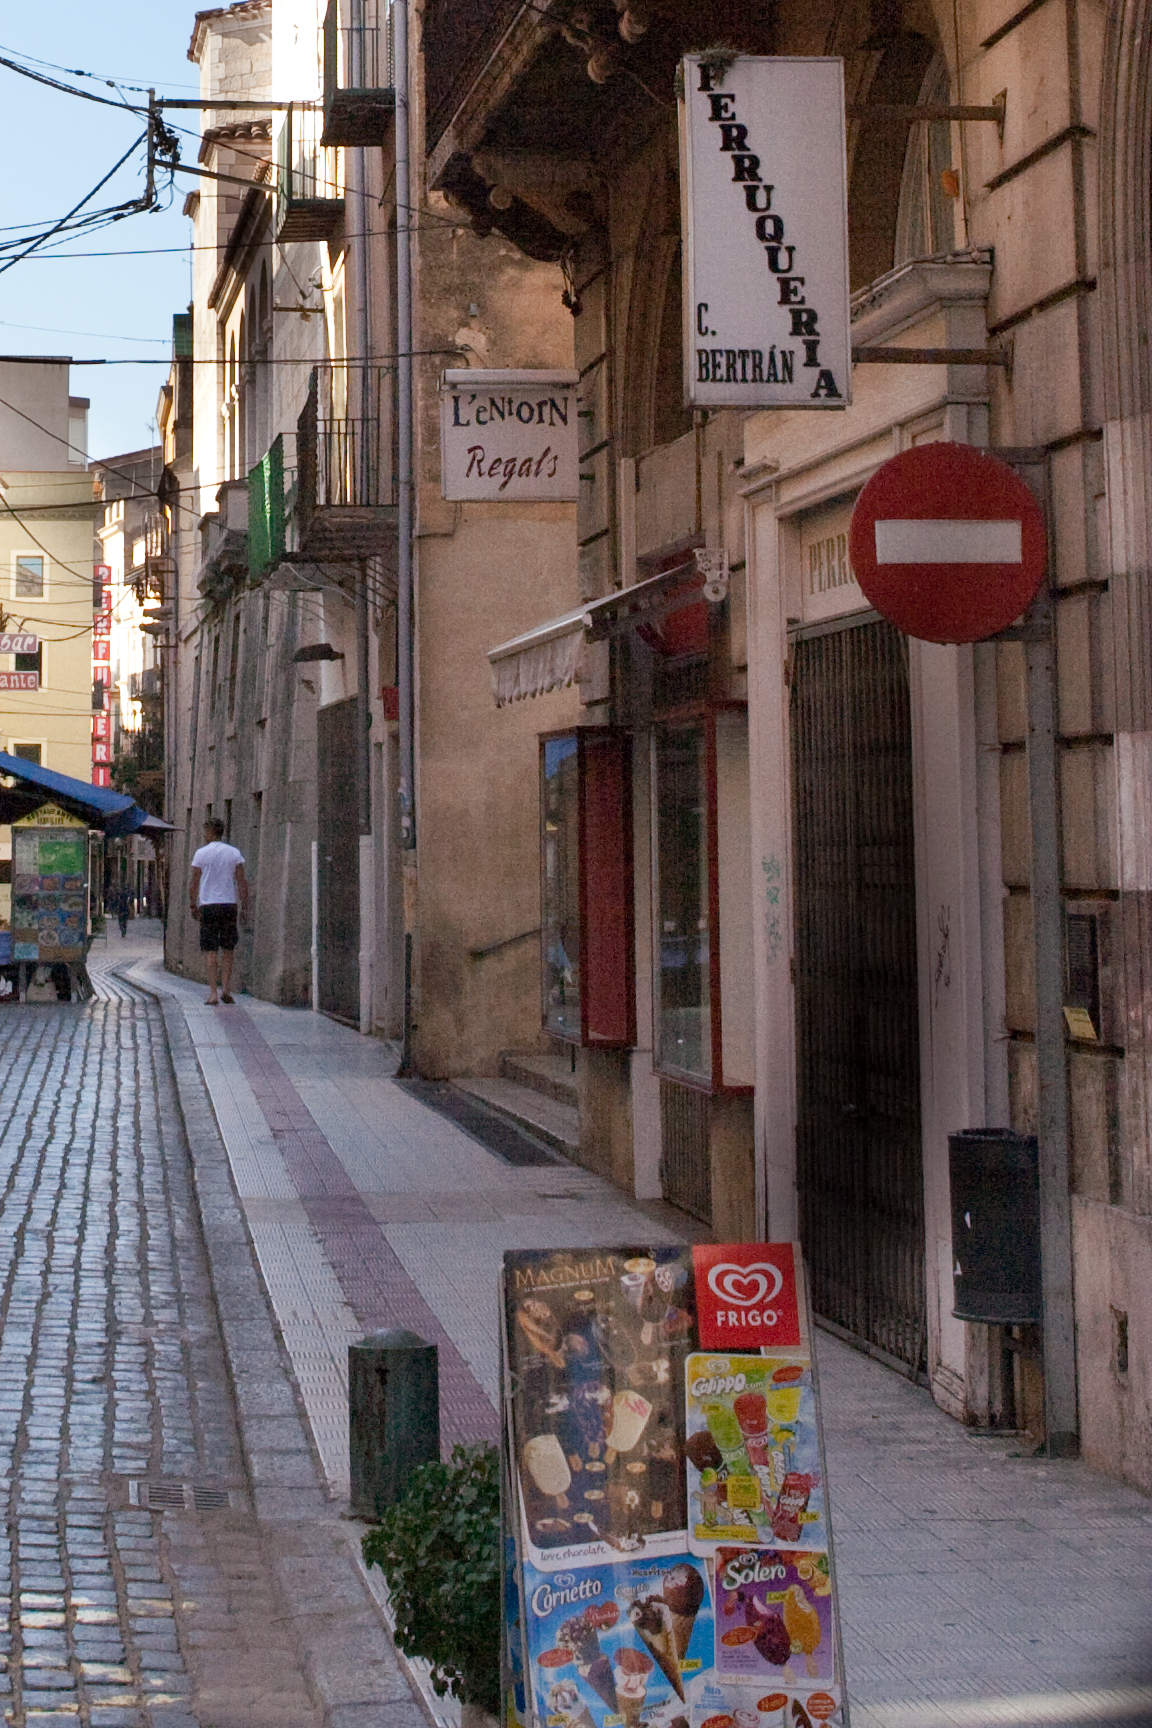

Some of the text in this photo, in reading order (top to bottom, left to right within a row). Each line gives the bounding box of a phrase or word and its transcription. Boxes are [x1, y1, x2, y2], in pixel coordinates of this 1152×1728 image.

[697, 62, 842, 399] PERRUQUERIA
[697, 302, 717, 337] C.
[696, 345, 795, 385] BERTRÁN
[465, 445, 559, 492] Regals
[514, 1255, 617, 1289] MAGNUM
[716, 1310, 778, 1327] FRIGO
[722, 1559, 787, 1591] Solero
[531, 1578, 602, 1617] Cornetto
